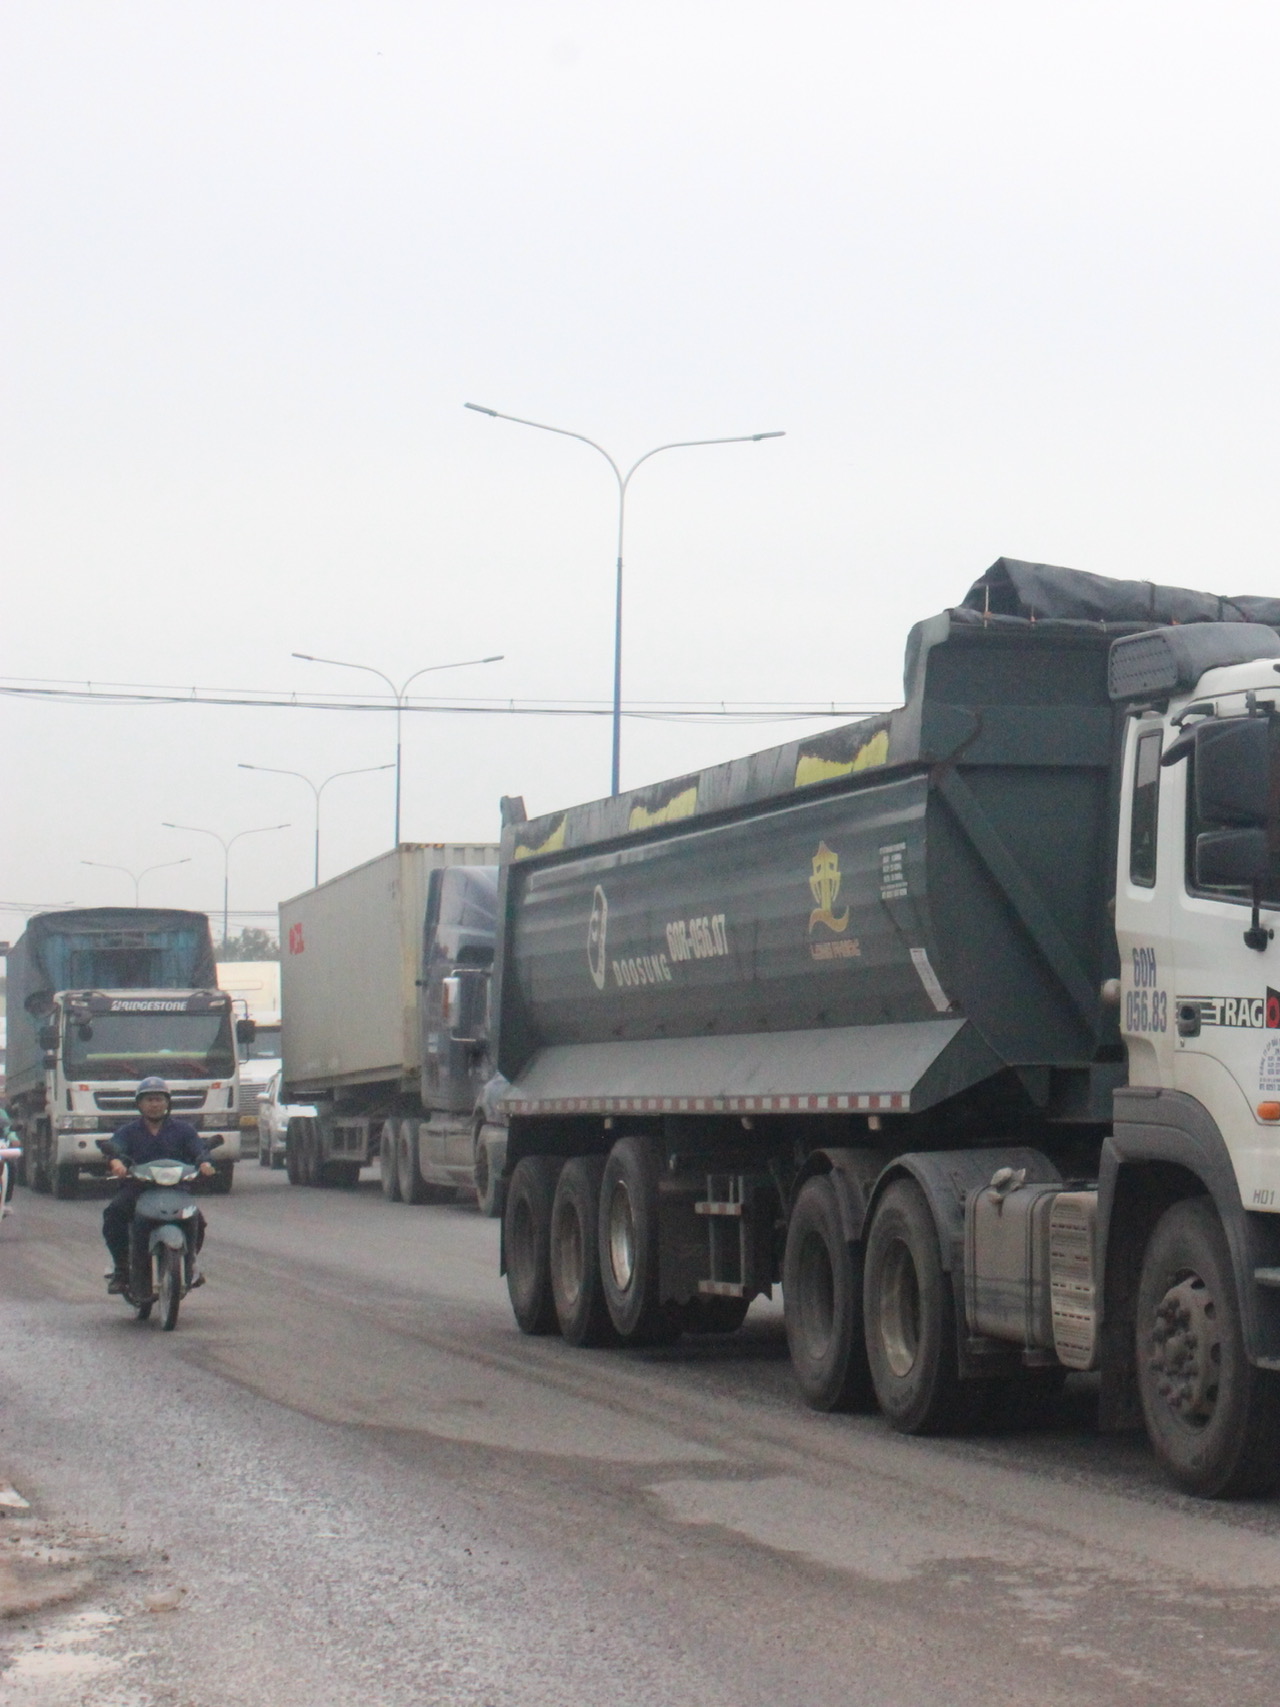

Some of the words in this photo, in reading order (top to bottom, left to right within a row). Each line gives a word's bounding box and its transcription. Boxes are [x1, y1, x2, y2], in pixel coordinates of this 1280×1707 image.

[612, 954, 672, 986] DOOSUNG
[1132, 947, 1157, 988] 60H
[111, 1000, 188, 1012] BRIDGESTONE
[1126, 990, 1168, 1033] 056.83
